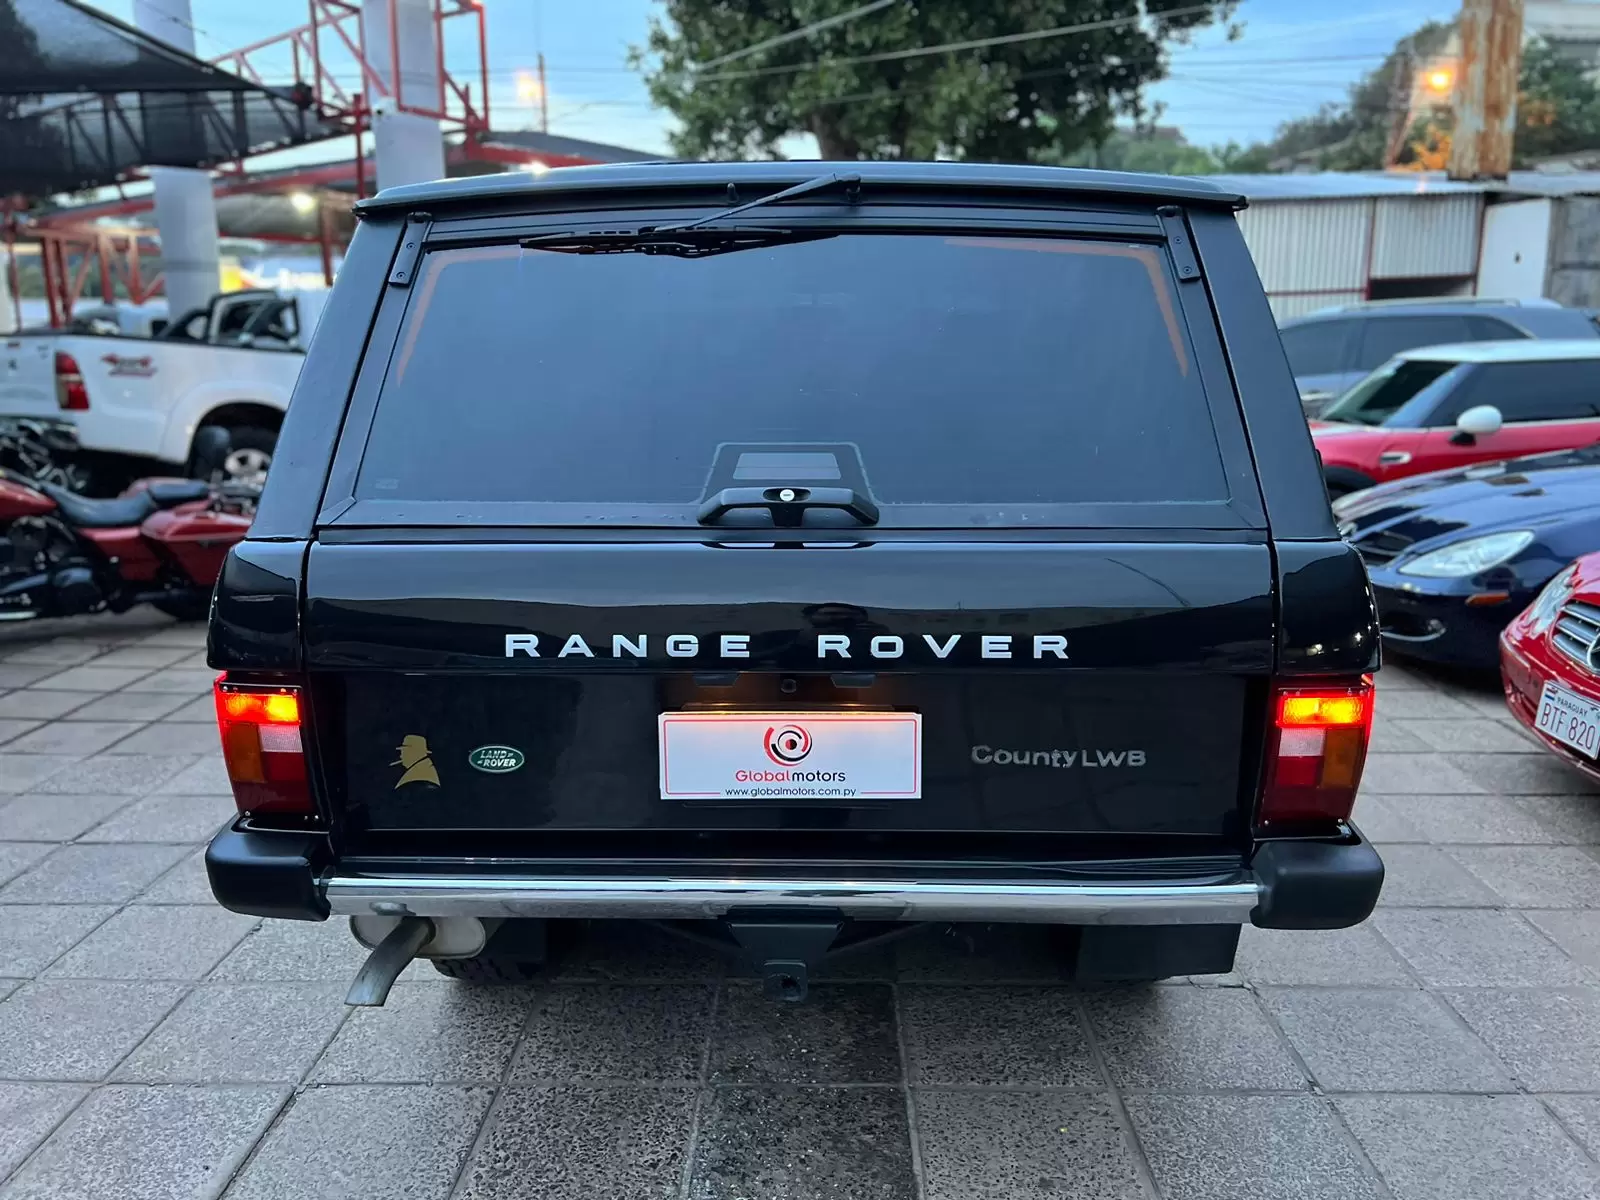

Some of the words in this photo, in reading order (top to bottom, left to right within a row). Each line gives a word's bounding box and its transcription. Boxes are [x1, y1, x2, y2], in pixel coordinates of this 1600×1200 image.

[505, 633, 751, 659] RANGE
[817, 633, 1070, 660] ROVER
[1557, 697, 1588, 717] PARAGUAY
[1541, 702, 1567, 733] BTF
[1568, 716, 1596, 750] 820
[480, 750, 507, 759] LAND
[483, 758, 516, 767] ROVER
[971, 744, 1077, 769] County
[1081, 749, 1147, 768] LWB
[725, 786, 857, 798] www.globalmotors.com.py
